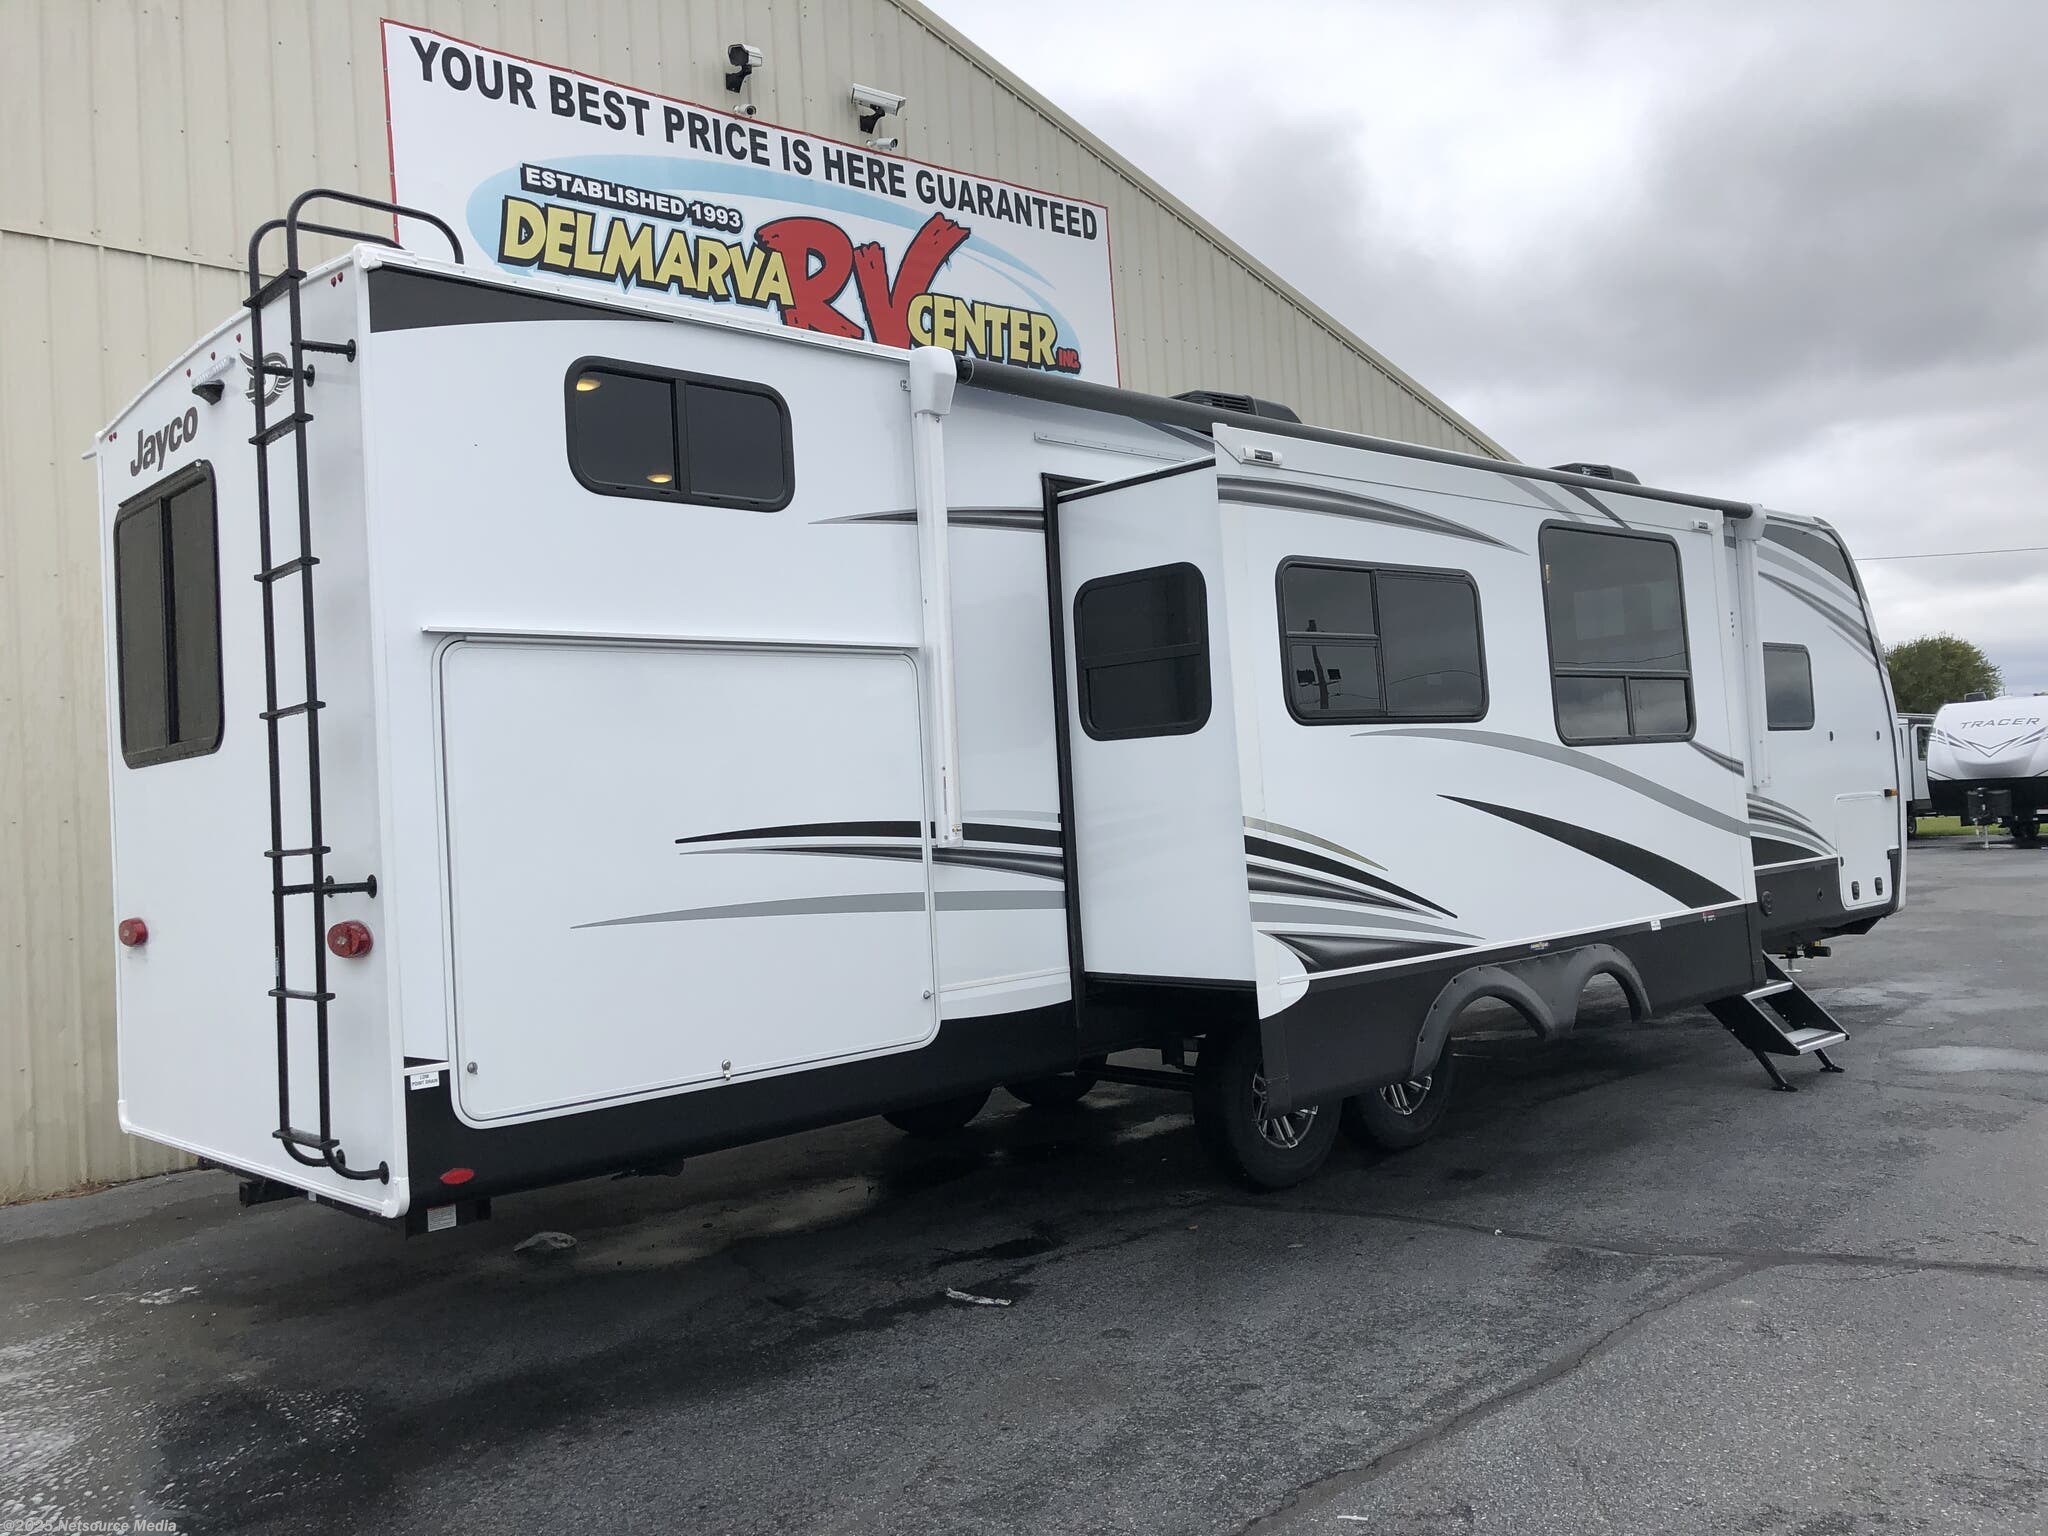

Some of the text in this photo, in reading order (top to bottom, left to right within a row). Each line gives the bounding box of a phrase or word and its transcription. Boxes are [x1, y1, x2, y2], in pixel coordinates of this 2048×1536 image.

[409, 36, 1097, 241] YOUR BEST PRICE IS HERE GUARANTEED
[526, 167, 741, 227] ESTABLISHED 1993
[502, 198, 1080, 369] DELMARVA RV CENTER INC.
[130, 406, 198, 477] Jayco
[1960, 717, 2040, 729] TRACER
